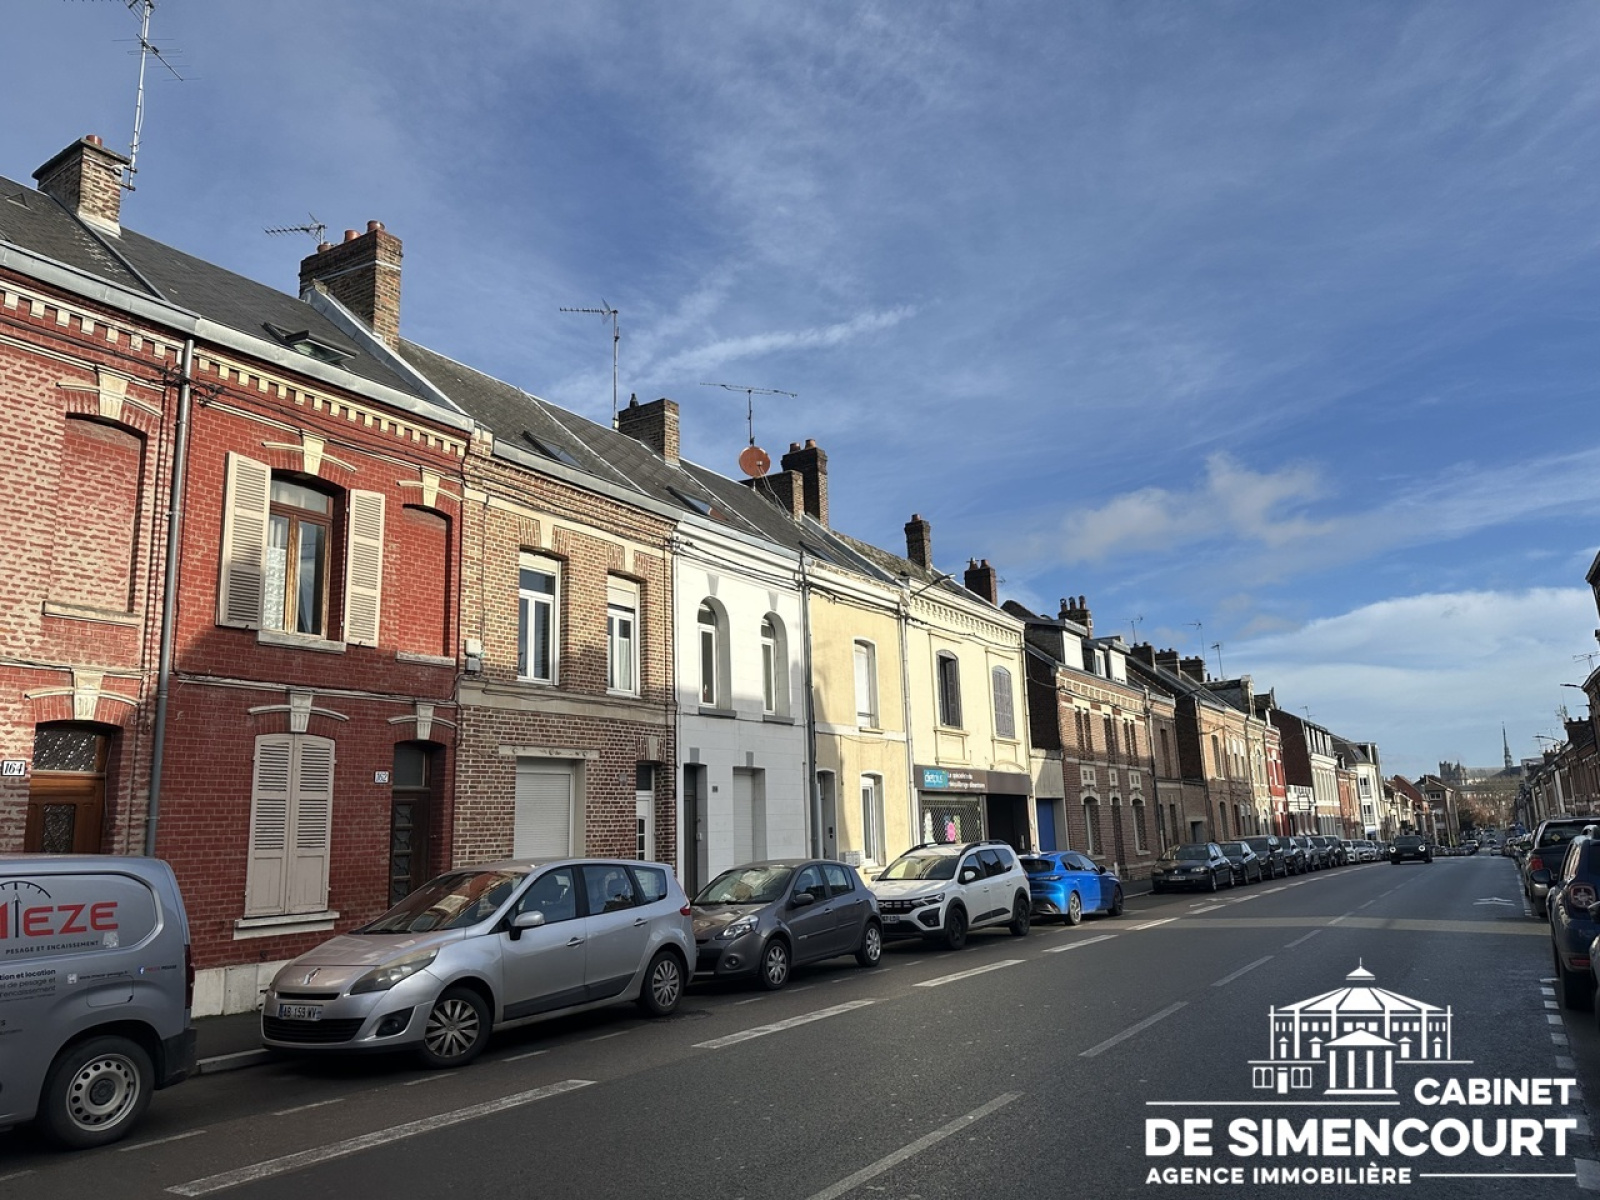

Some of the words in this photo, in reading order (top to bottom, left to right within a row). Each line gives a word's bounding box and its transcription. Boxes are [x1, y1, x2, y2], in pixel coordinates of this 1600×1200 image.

[4, 763, 23, 774] 164
[0, 901, 118, 939] IEZE
[5, 946, 34, 955] PESAGE
[47, 940, 99, 950] ENCAISSEMENT
[25, 969, 56, 977] location
[19, 978, 47, 988] pesage
